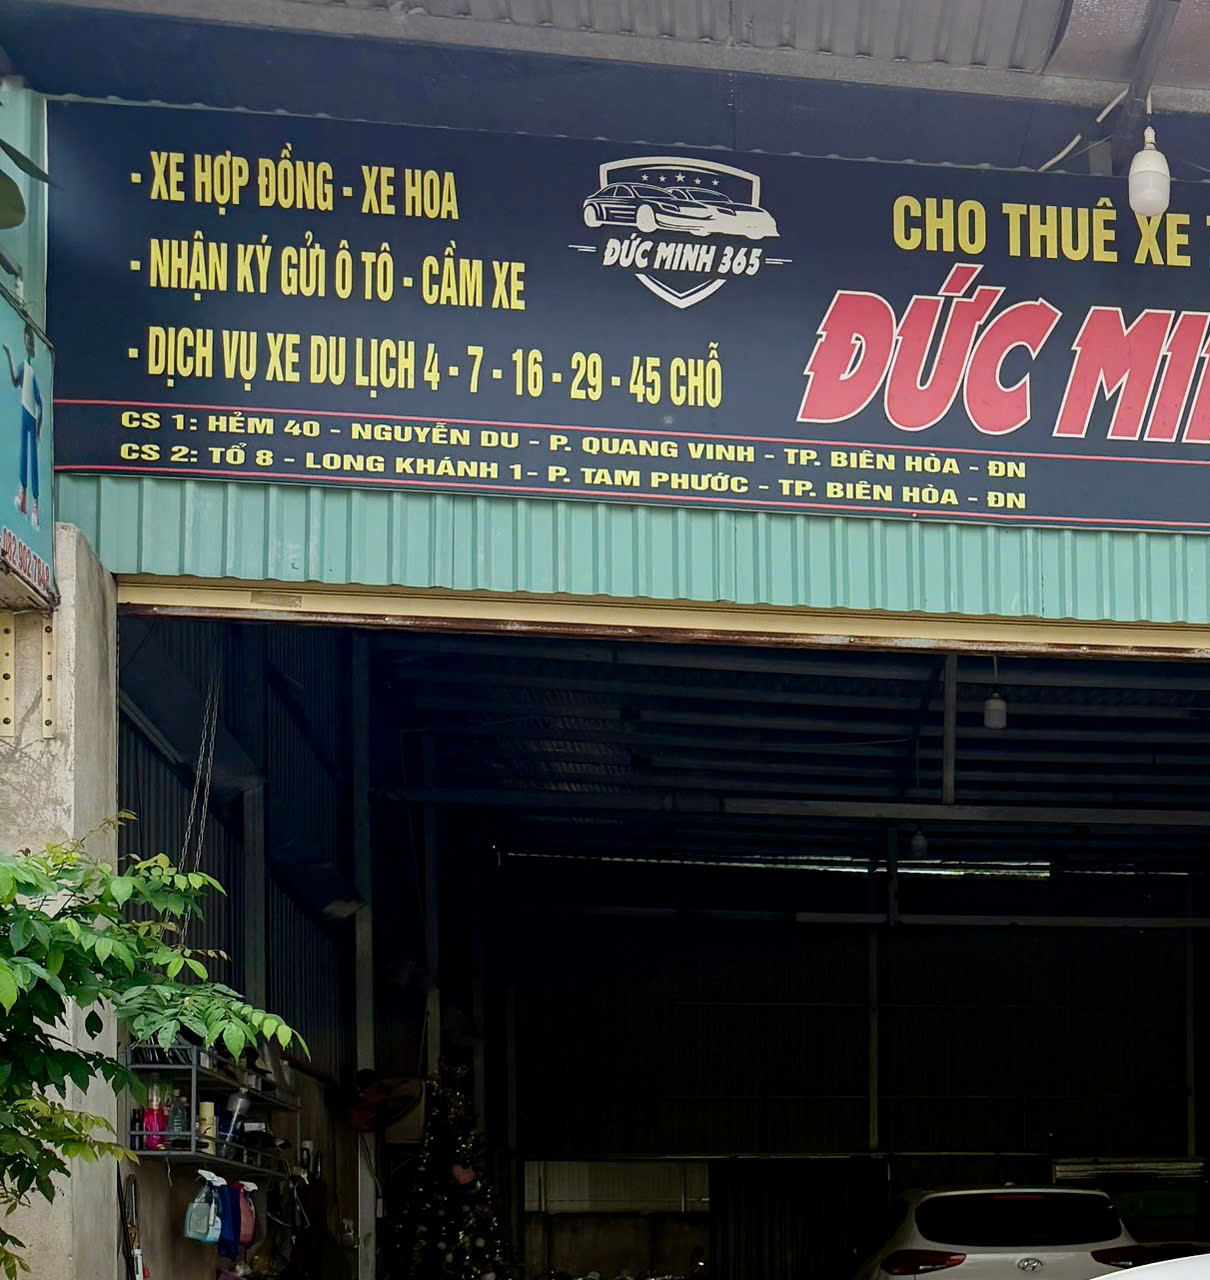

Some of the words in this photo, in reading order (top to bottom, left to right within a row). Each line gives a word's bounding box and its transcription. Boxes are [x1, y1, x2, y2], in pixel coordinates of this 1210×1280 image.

[150, 151, 185, 202] XE
[194, 151, 249, 216] HỢP
[257, 143, 334, 212] ĐỒNG
[361, 166, 396, 215] XE
[404, 168, 459, 220] HOA
[603, 233, 653, 269] ĐỨC
[653, 241, 716, 273] MINH
[717, 246, 763, 276] 365
[892, 195, 987, 255] CHO
[1001, 197, 1118, 263] THUÊ
[1134, 207, 1192, 267] XE
[149, 231, 228, 302] NHẬN
[236, 234, 272, 294] KÝ
[280, 231, 326, 298] GỬI
[335, 239, 353, 300] Ô
[360, 243, 394, 302] TÔ
[421, 242, 483, 308] CẦM
[491, 261, 526, 311] XE
[147, 326, 214, 388] DỊCH
[222, 331, 257, 392] VỤ
[265, 333, 301, 383] XE
[309, 335, 347, 386] DU
[355, 338, 415, 399] LỊCH
[423, 343, 441, 391] 4
[466, 346, 484, 394] 7
[511, 349, 544, 398] 16
[569, 352, 603, 401] 29
[628, 355, 662, 405] 45
[669, 343, 723, 409] CHỖ
[797, 263, 1062, 434] ĐỨC
[120, 444, 161, 461] CS
[170, 447, 197, 463] 2:
[208, 442, 246, 465] TỔ
[255, 450, 273, 467] 8
[305, 452, 385, 473] LONG
[395, 457, 498, 479] KHÁNH
[547, 466, 567, 483] P.
[580, 468, 641, 488] TAM
[650, 471, 748, 494] PHƯỚC
[778, 479, 813, 497] TP.
[826, 482, 893, 502] BIÊN
[901, 483, 960, 505] HÒA
[987, 491, 1026, 510] ĐN
[121, 411, 161, 430] CS
[172, 415, 196, 431] 1:
[207, 410, 274, 435] HẺM
[284, 421, 321, 438] 40
[351, 423, 470, 446] NGUYỄN
[479, 431, 519, 449] DU
[549, 435, 569, 452] P.
[581, 437, 678, 459] QUANG
[687, 443, 755, 463] VINH
[783, 448, 817, 466] TP.
[831, 451, 896, 471] BIÊN
[904, 452, 961, 475] HÒA
[987, 461, 1026, 479] ĐN
